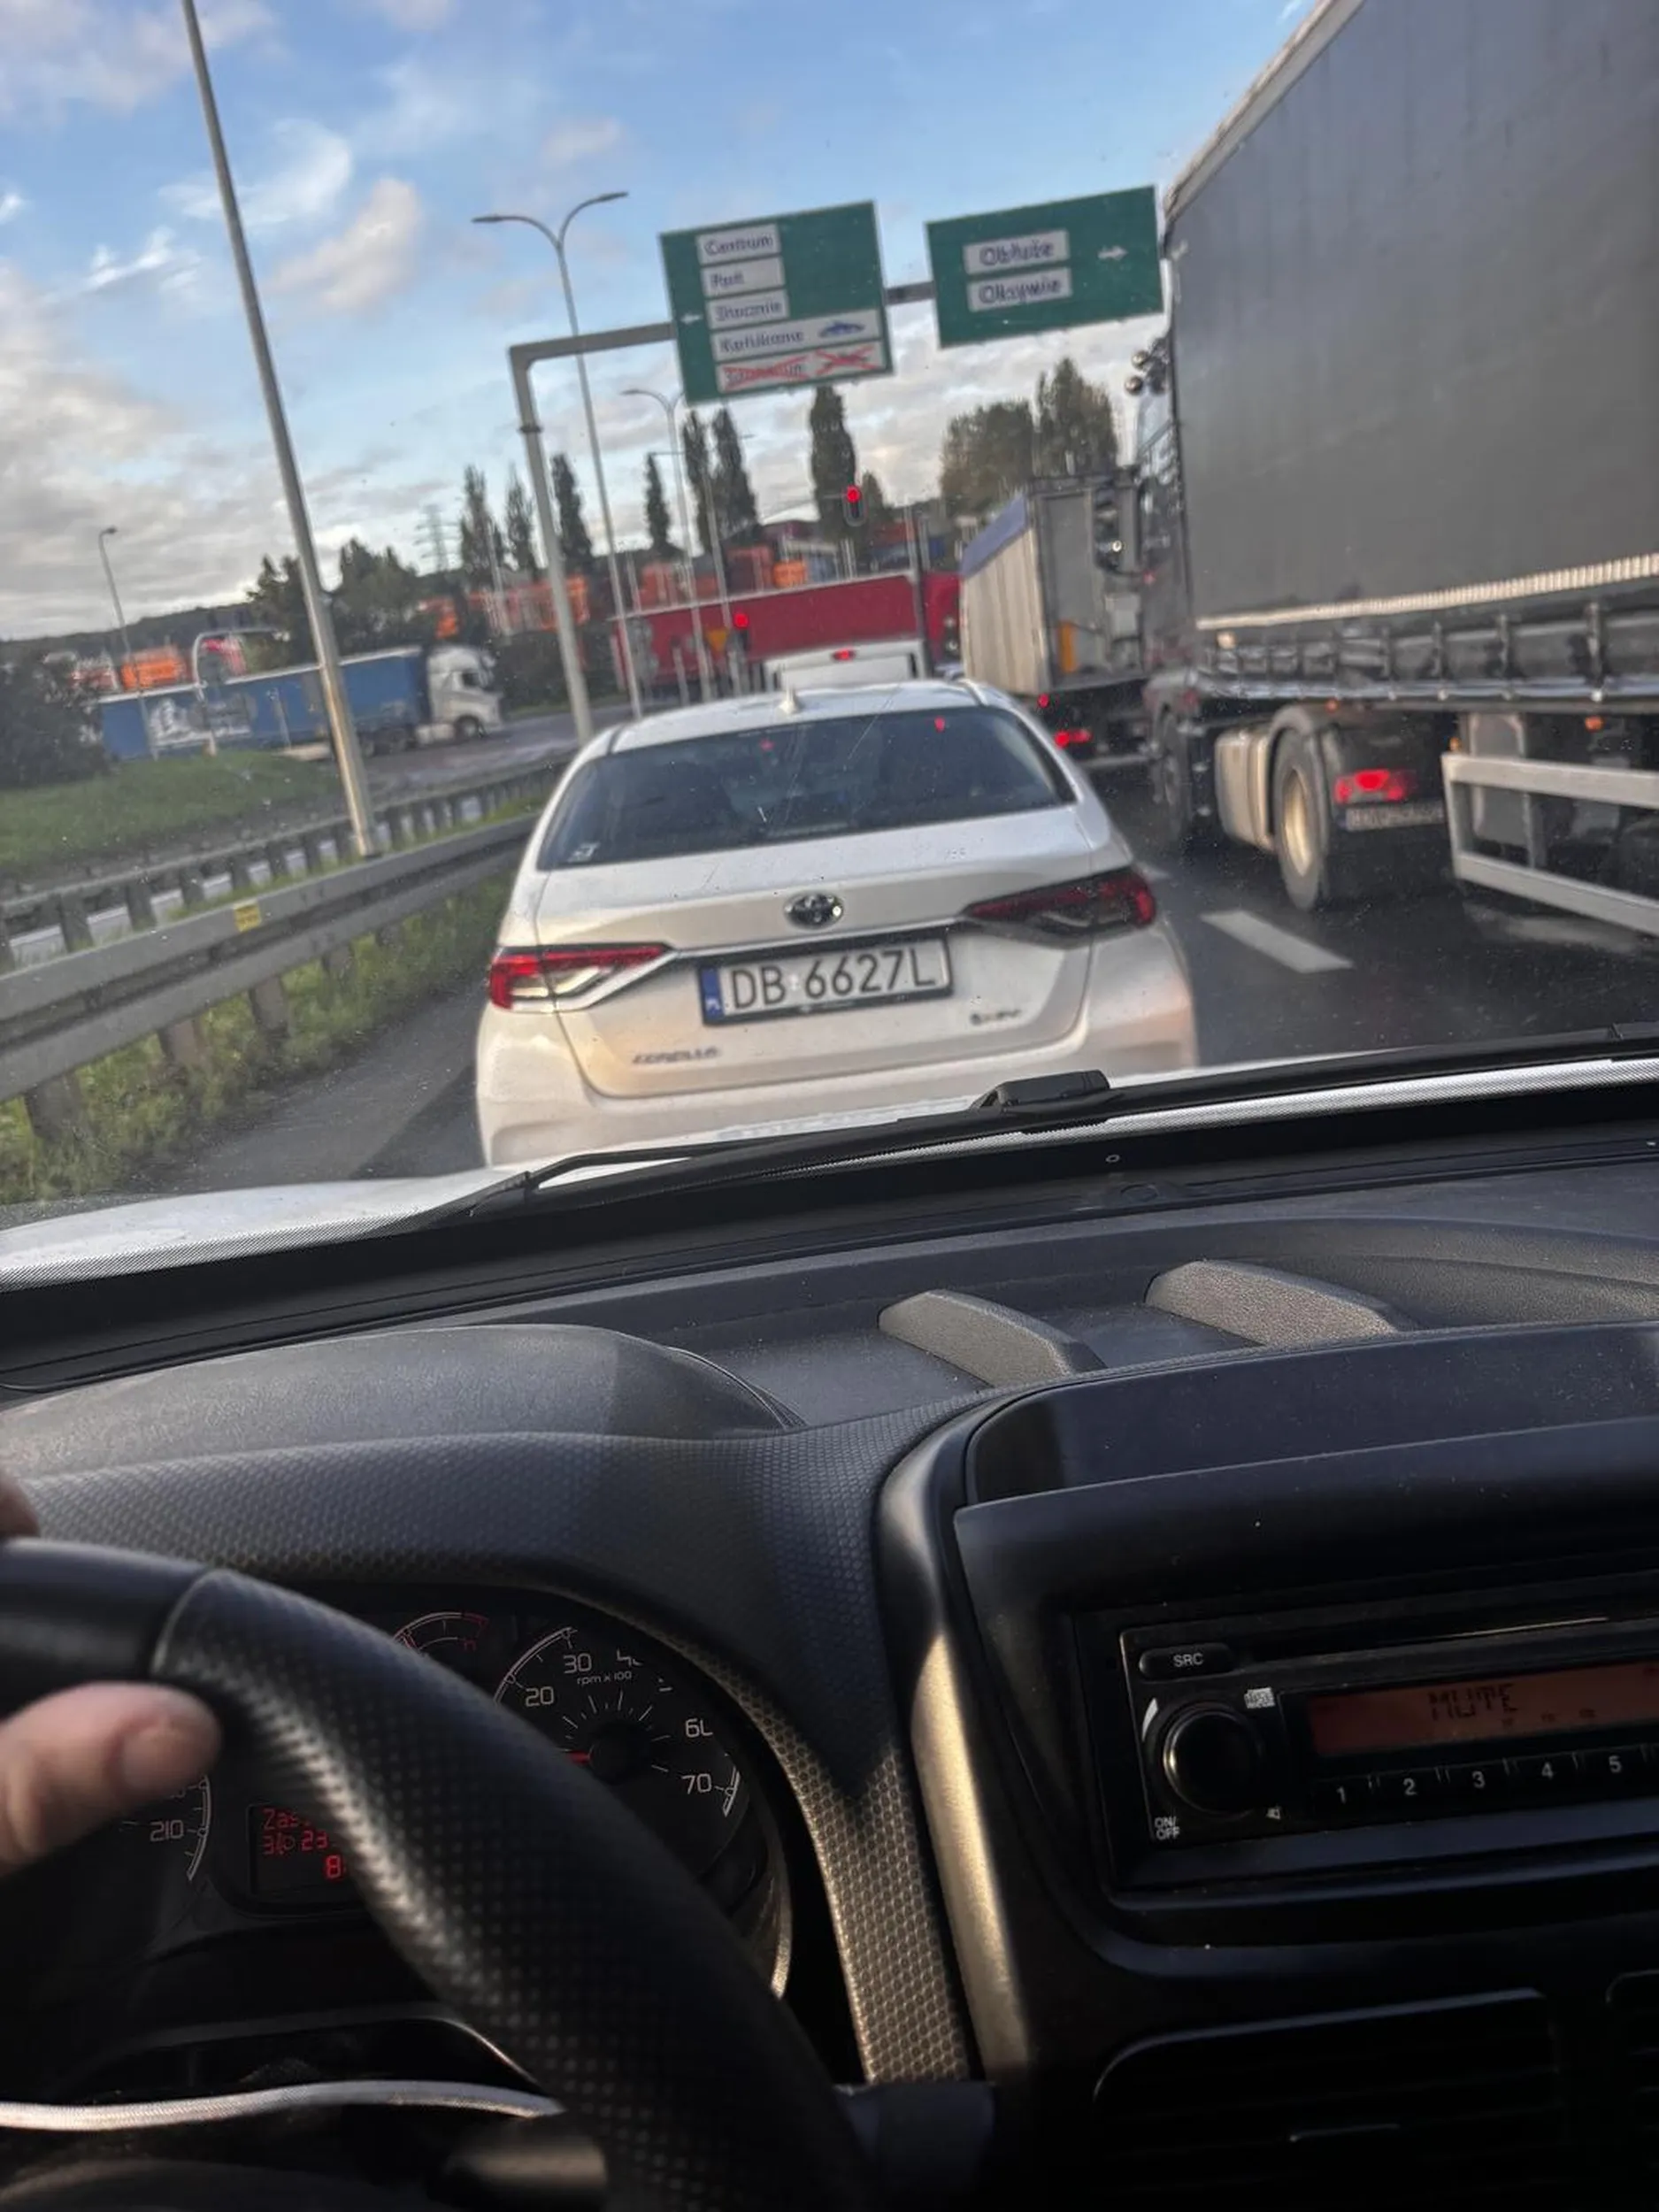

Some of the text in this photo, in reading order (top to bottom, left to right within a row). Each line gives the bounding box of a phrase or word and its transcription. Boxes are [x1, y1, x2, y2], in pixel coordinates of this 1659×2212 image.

[704, 234, 775, 257] Centrum
[732, 947, 936, 1009] DB 6627L
[563, 1652, 593, 1674] 30
[1172, 1652, 1204, 1668] SRC
[576, 1675, 602, 1688] rpm
[614, 1671, 633, 1681] 100
[525, 1686, 555, 1709] 20
[1541, 1760, 1555, 1781] 4
[1608, 1754, 1623, 1775] 5
[681, 1772, 713, 1795] 70
[1402, 1777, 1417, 1797] 2
[1471, 1769, 1486, 1790] 3
[1335, 1785, 1347, 1806] 1
[150, 1819, 185, 1843] 210
[1156, 1825, 1181, 1840] OFF
